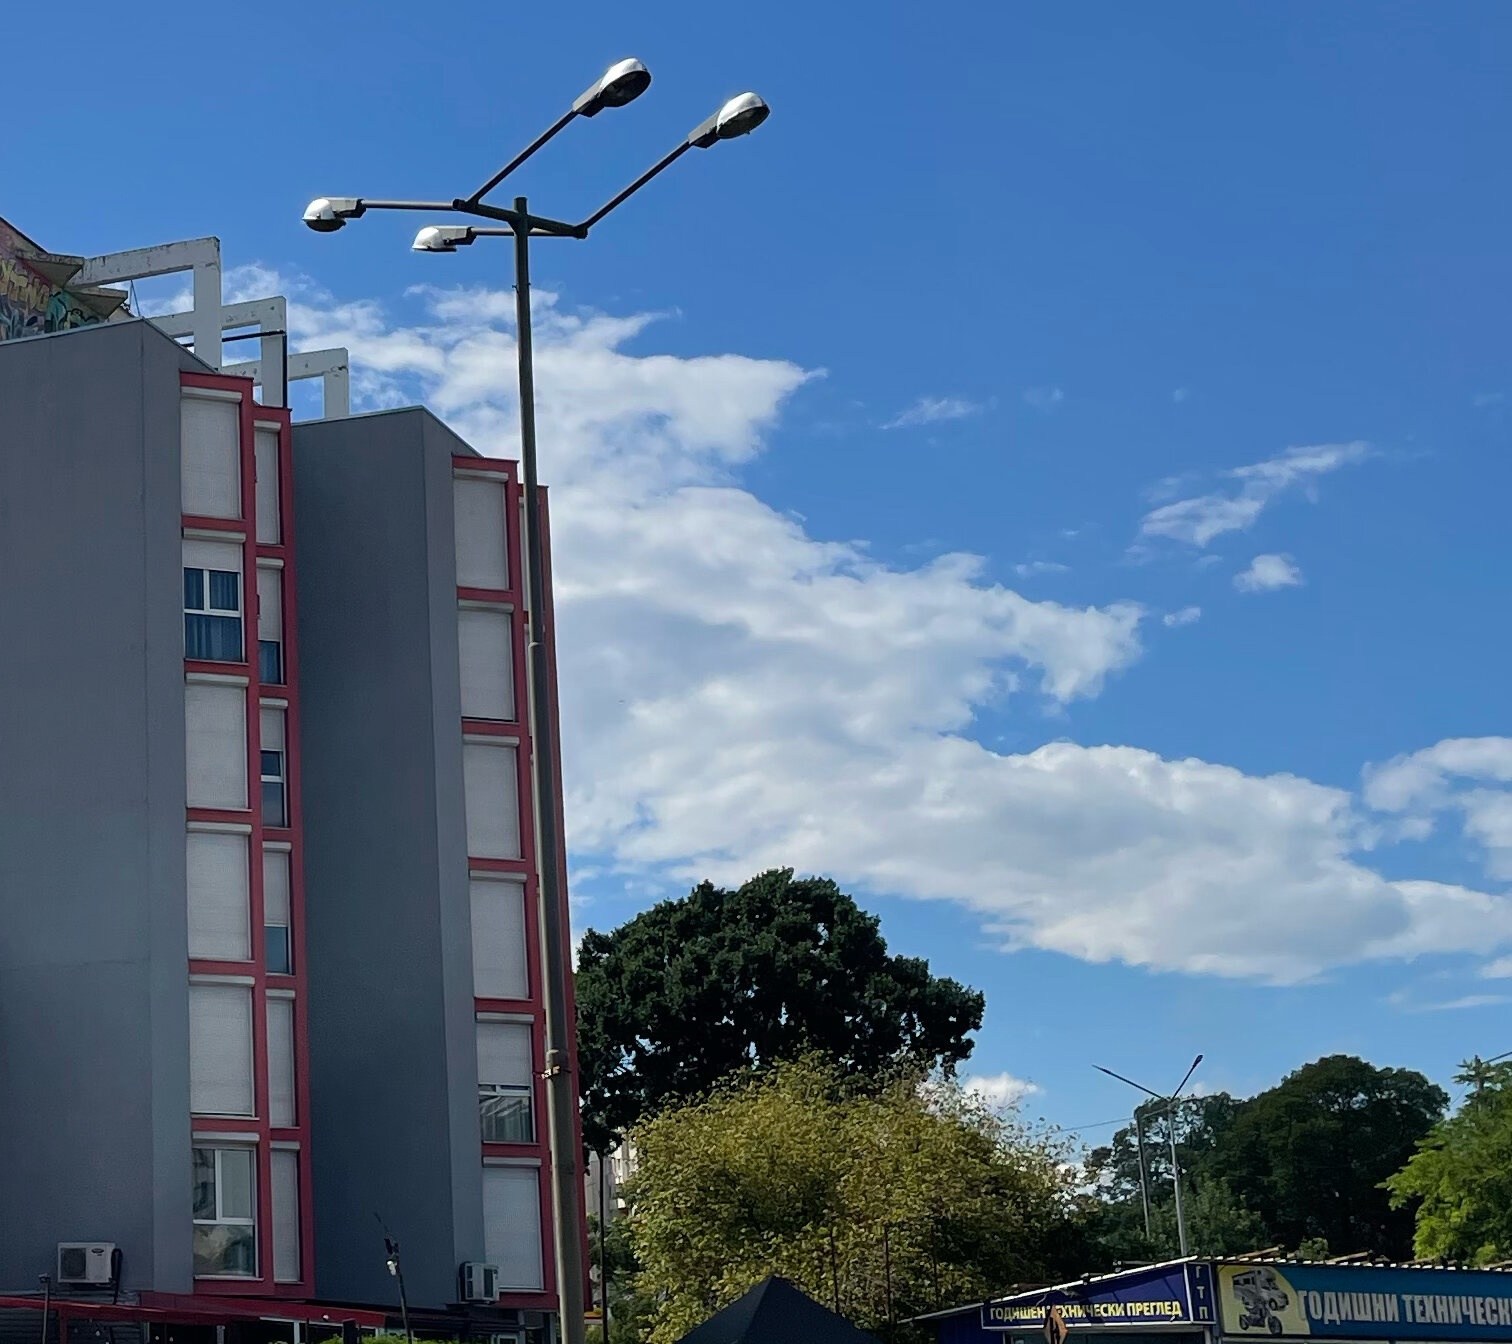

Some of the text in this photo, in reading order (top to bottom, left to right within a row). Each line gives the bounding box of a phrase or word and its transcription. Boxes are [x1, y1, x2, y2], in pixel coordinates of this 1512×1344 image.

[990, 1300, 1182, 1322] ГОДИШЕН ЕХНИЧЕСКИ ПРЕГЛЕД
[1195, 1265, 1209, 1320] ГТП
[1296, 1289, 1512, 1326] ГОДИШНИ ТЕХНИЧЕСК
